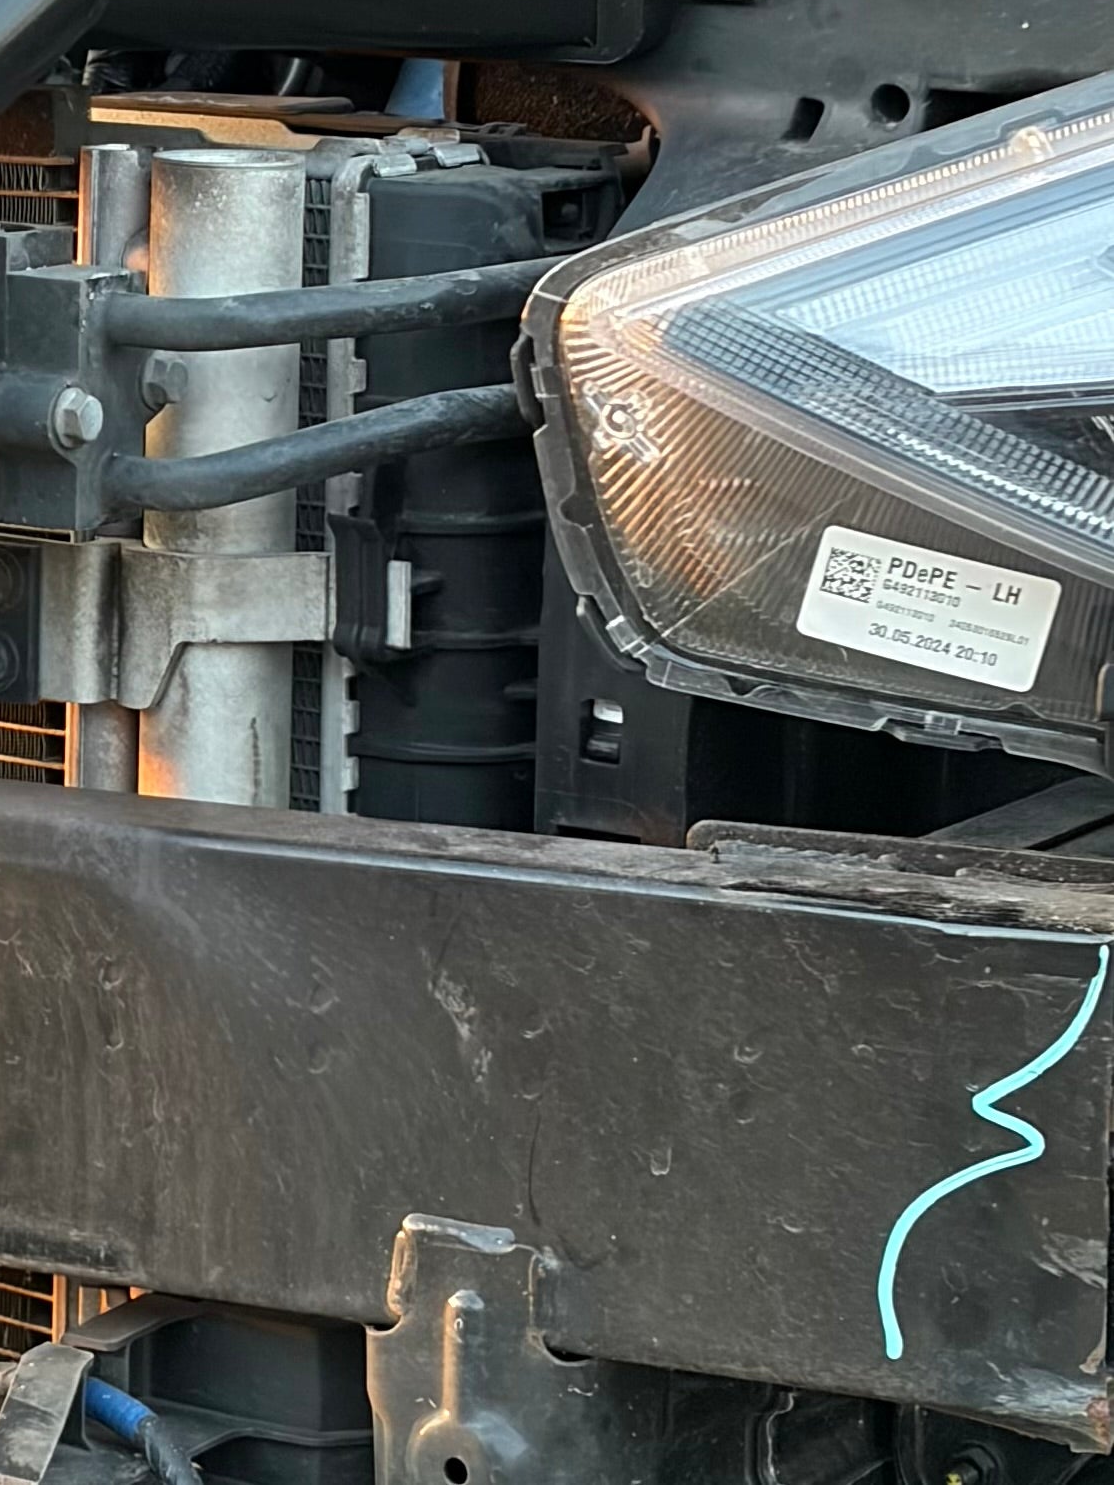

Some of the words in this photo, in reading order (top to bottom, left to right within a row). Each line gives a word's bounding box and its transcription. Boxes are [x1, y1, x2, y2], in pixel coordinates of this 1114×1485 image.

[887, 557, 959, 590] PDePE
[992, 582, 1022, 605] LH
[868, 622, 952, 655] 30.05.2024
[954, 645, 998, 667] 20:10
